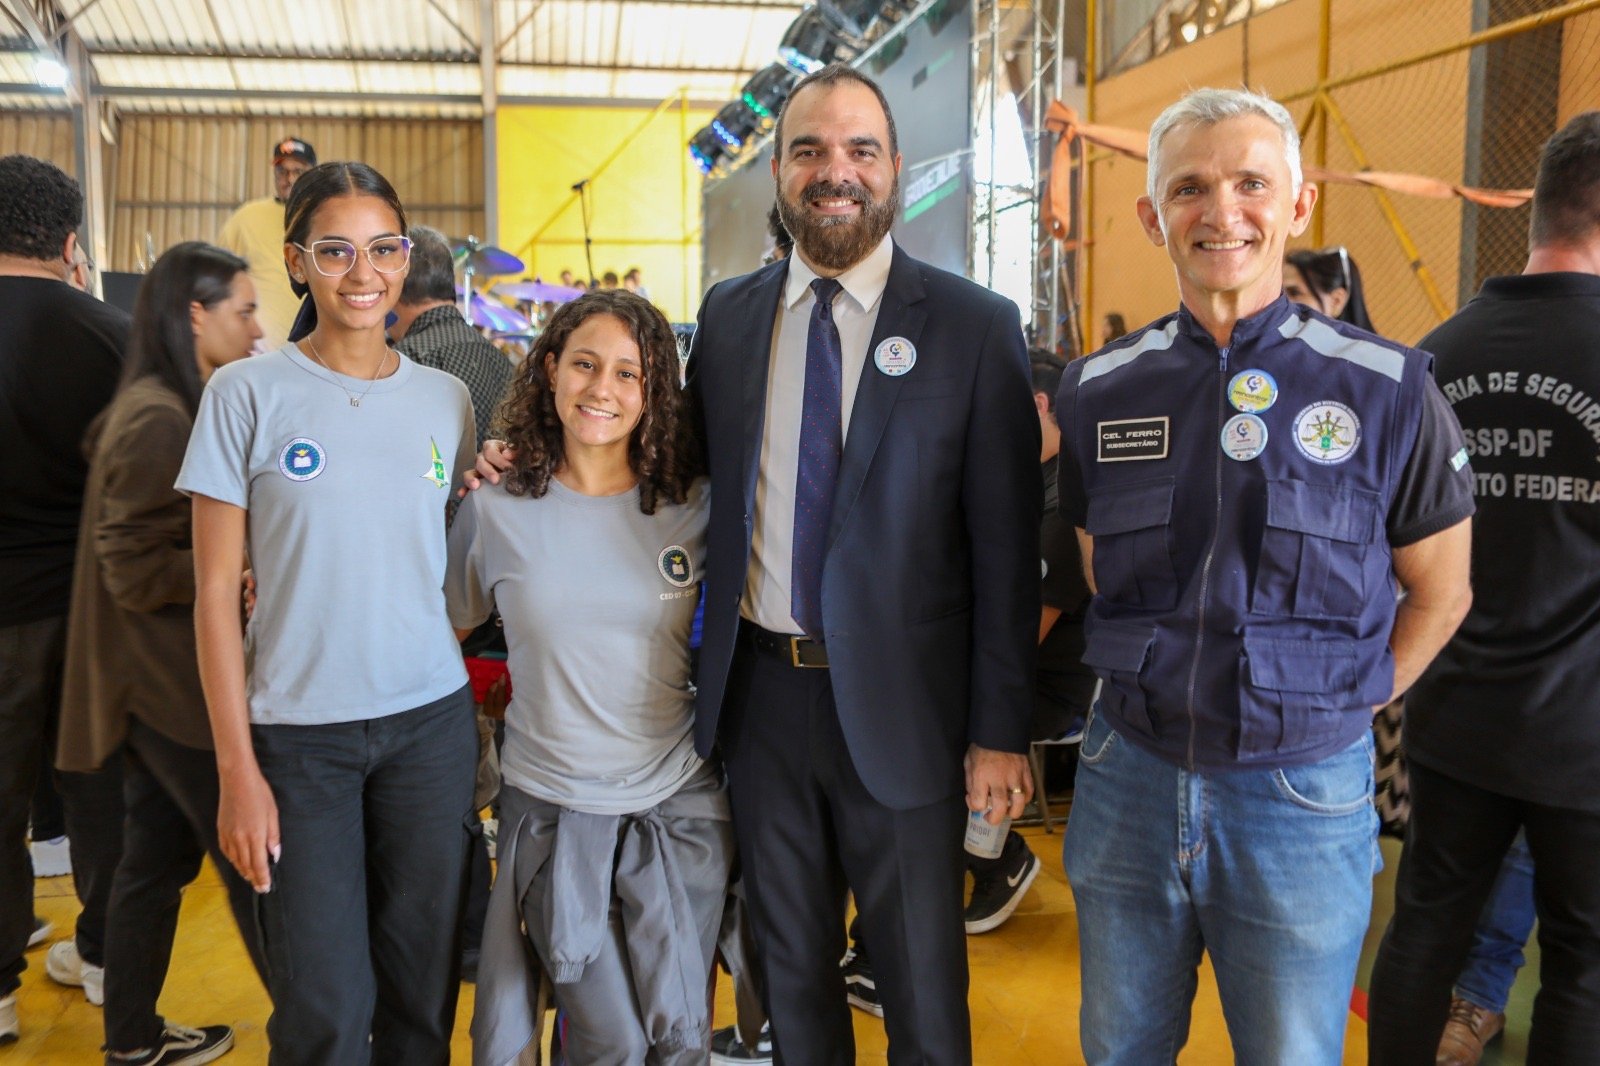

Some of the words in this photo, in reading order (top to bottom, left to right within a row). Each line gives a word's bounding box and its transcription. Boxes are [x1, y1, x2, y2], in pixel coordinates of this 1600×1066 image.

[1488, 372, 1519, 393] DE
[1102, 432, 1121, 440] CEL
[1126, 429, 1162, 438] FERRO
[1463, 428, 1553, 457] SSP-DF
[1106, 440, 1159, 449] SUBSECRETÁRIO
[1514, 474, 1600, 503] FEDERA
[660, 592, 674, 600] CED
